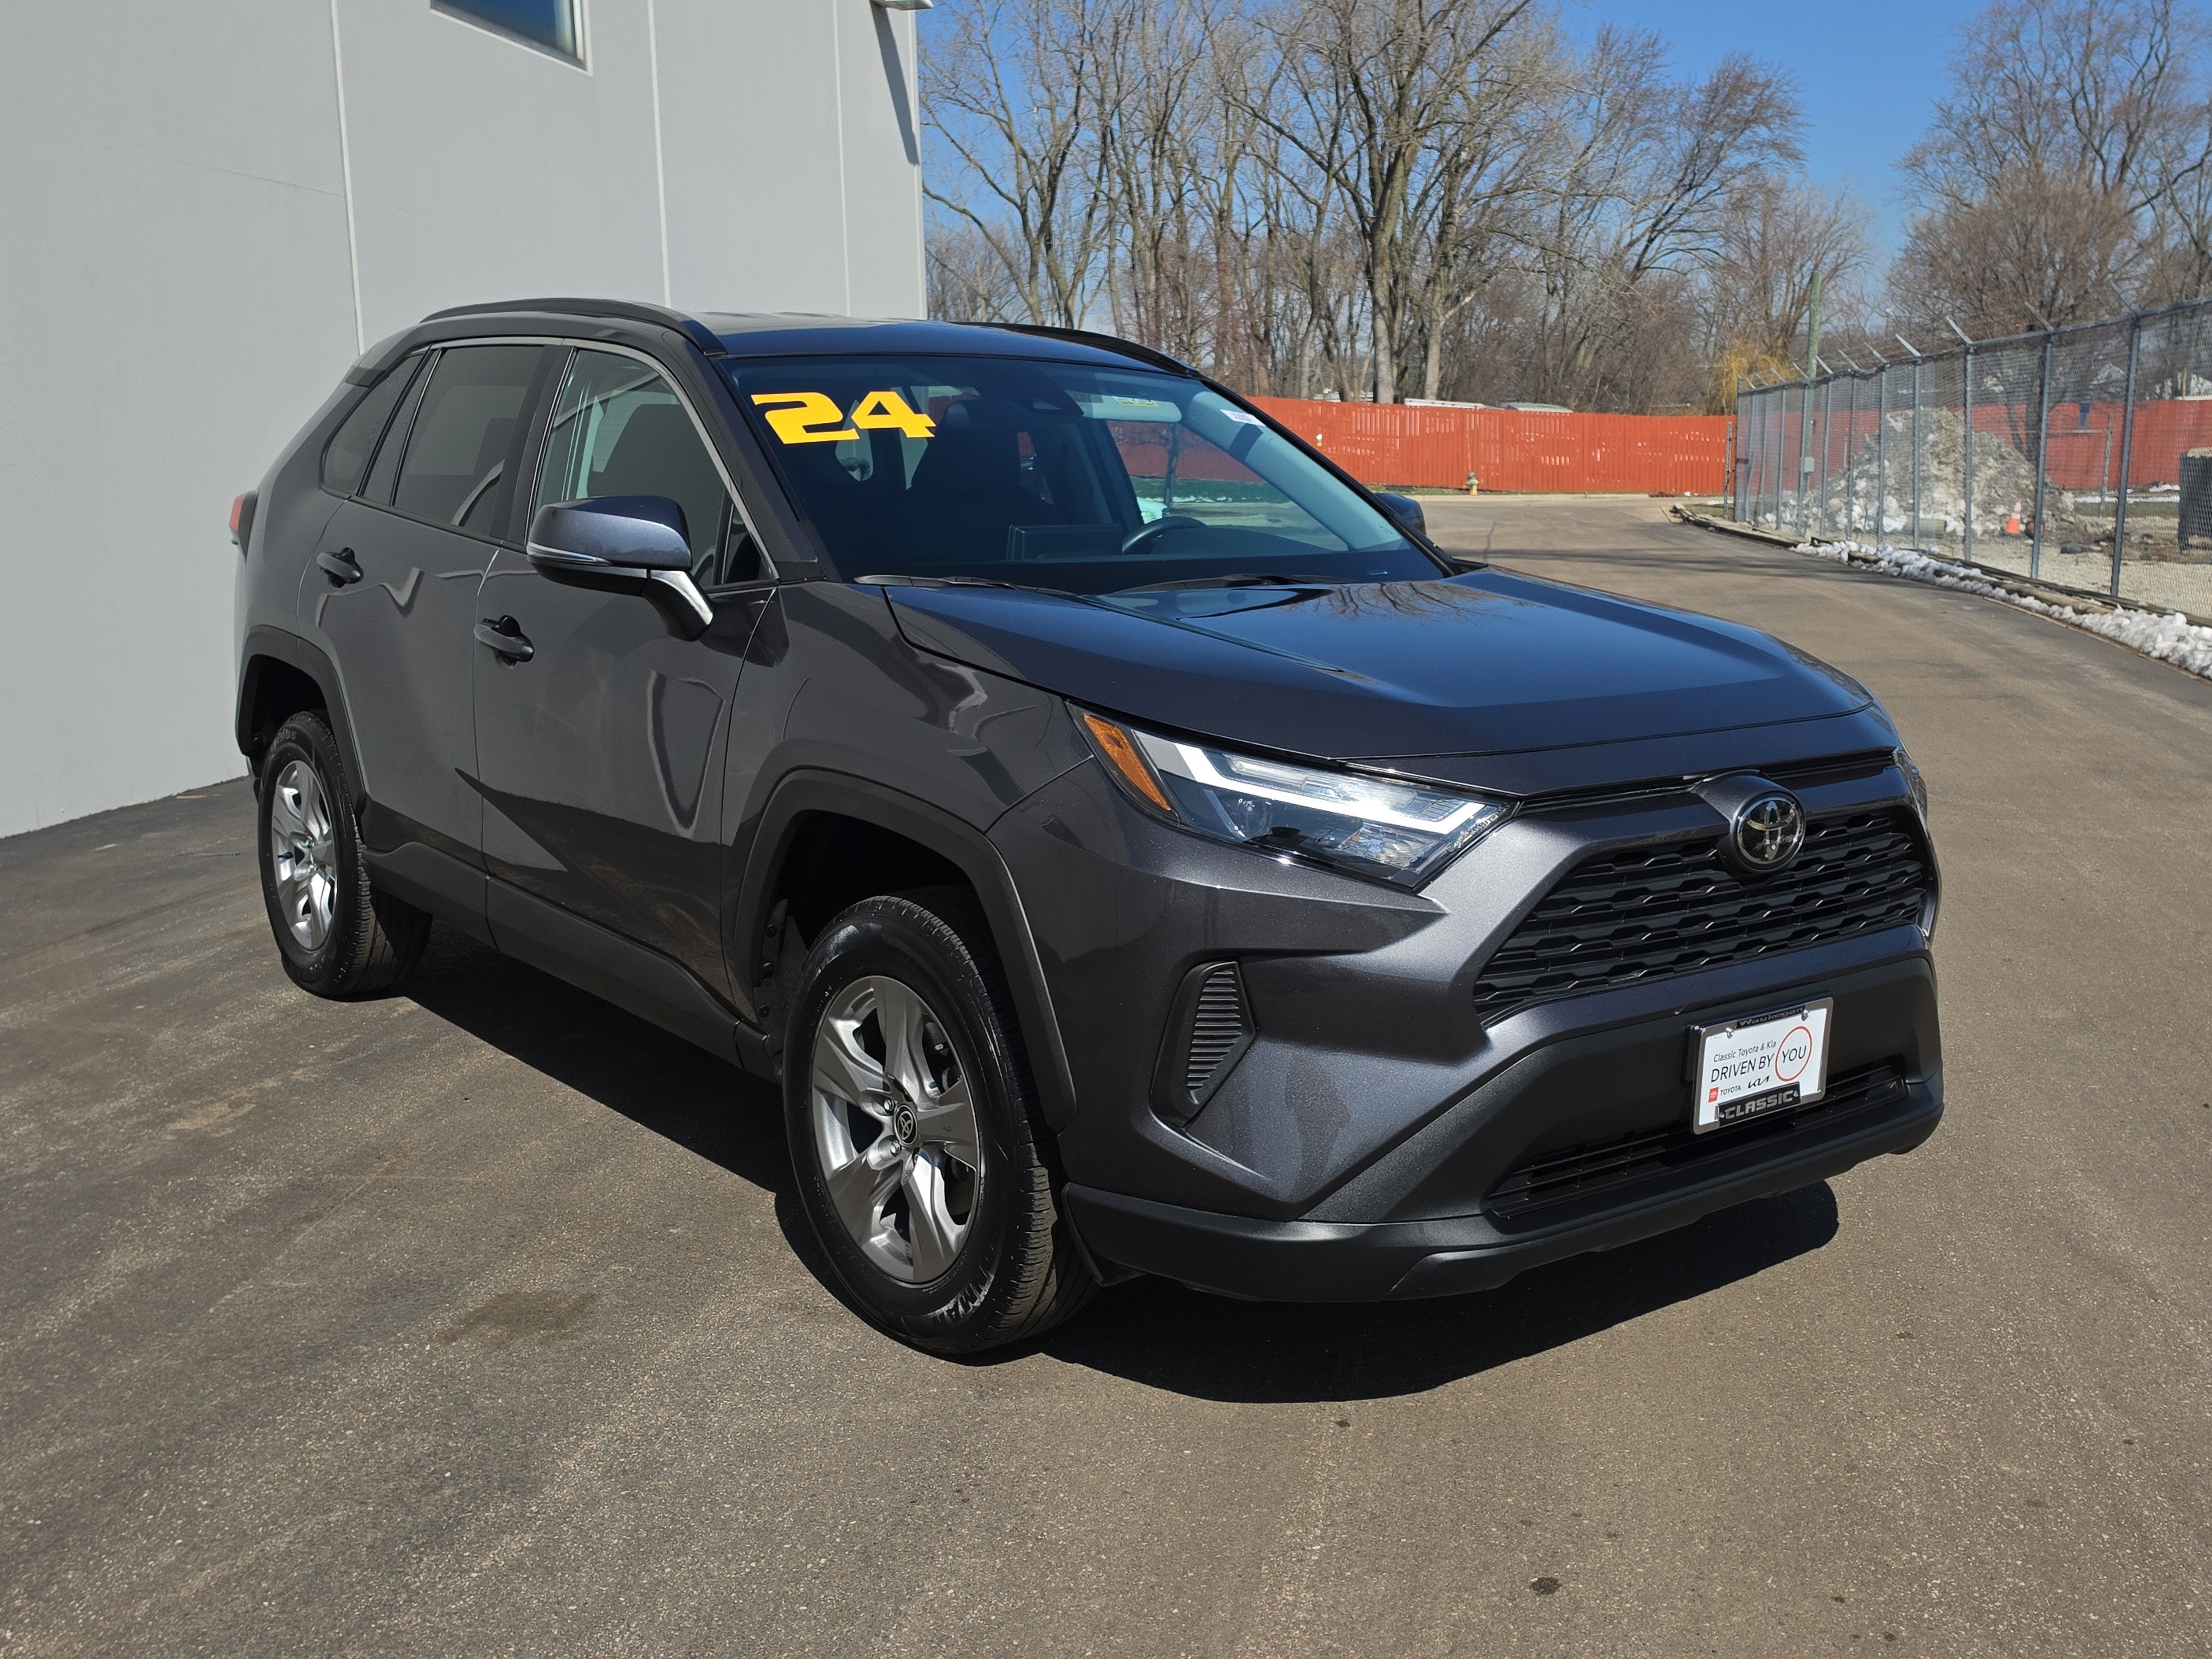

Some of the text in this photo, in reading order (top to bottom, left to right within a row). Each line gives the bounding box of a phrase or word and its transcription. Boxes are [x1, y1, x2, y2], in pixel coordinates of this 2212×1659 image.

[751, 391, 936, 444] 24
[1740, 1007, 1803, 1026] Waukegan
[1711, 1045, 1807, 1083] DRIVEN BY YOU
[1714, 1040, 1777, 1063] Classic Toyota & Kia
[1720, 1085, 1741, 1096] TOYOTA
[1724, 1090, 1794, 1120] CLASSIC
